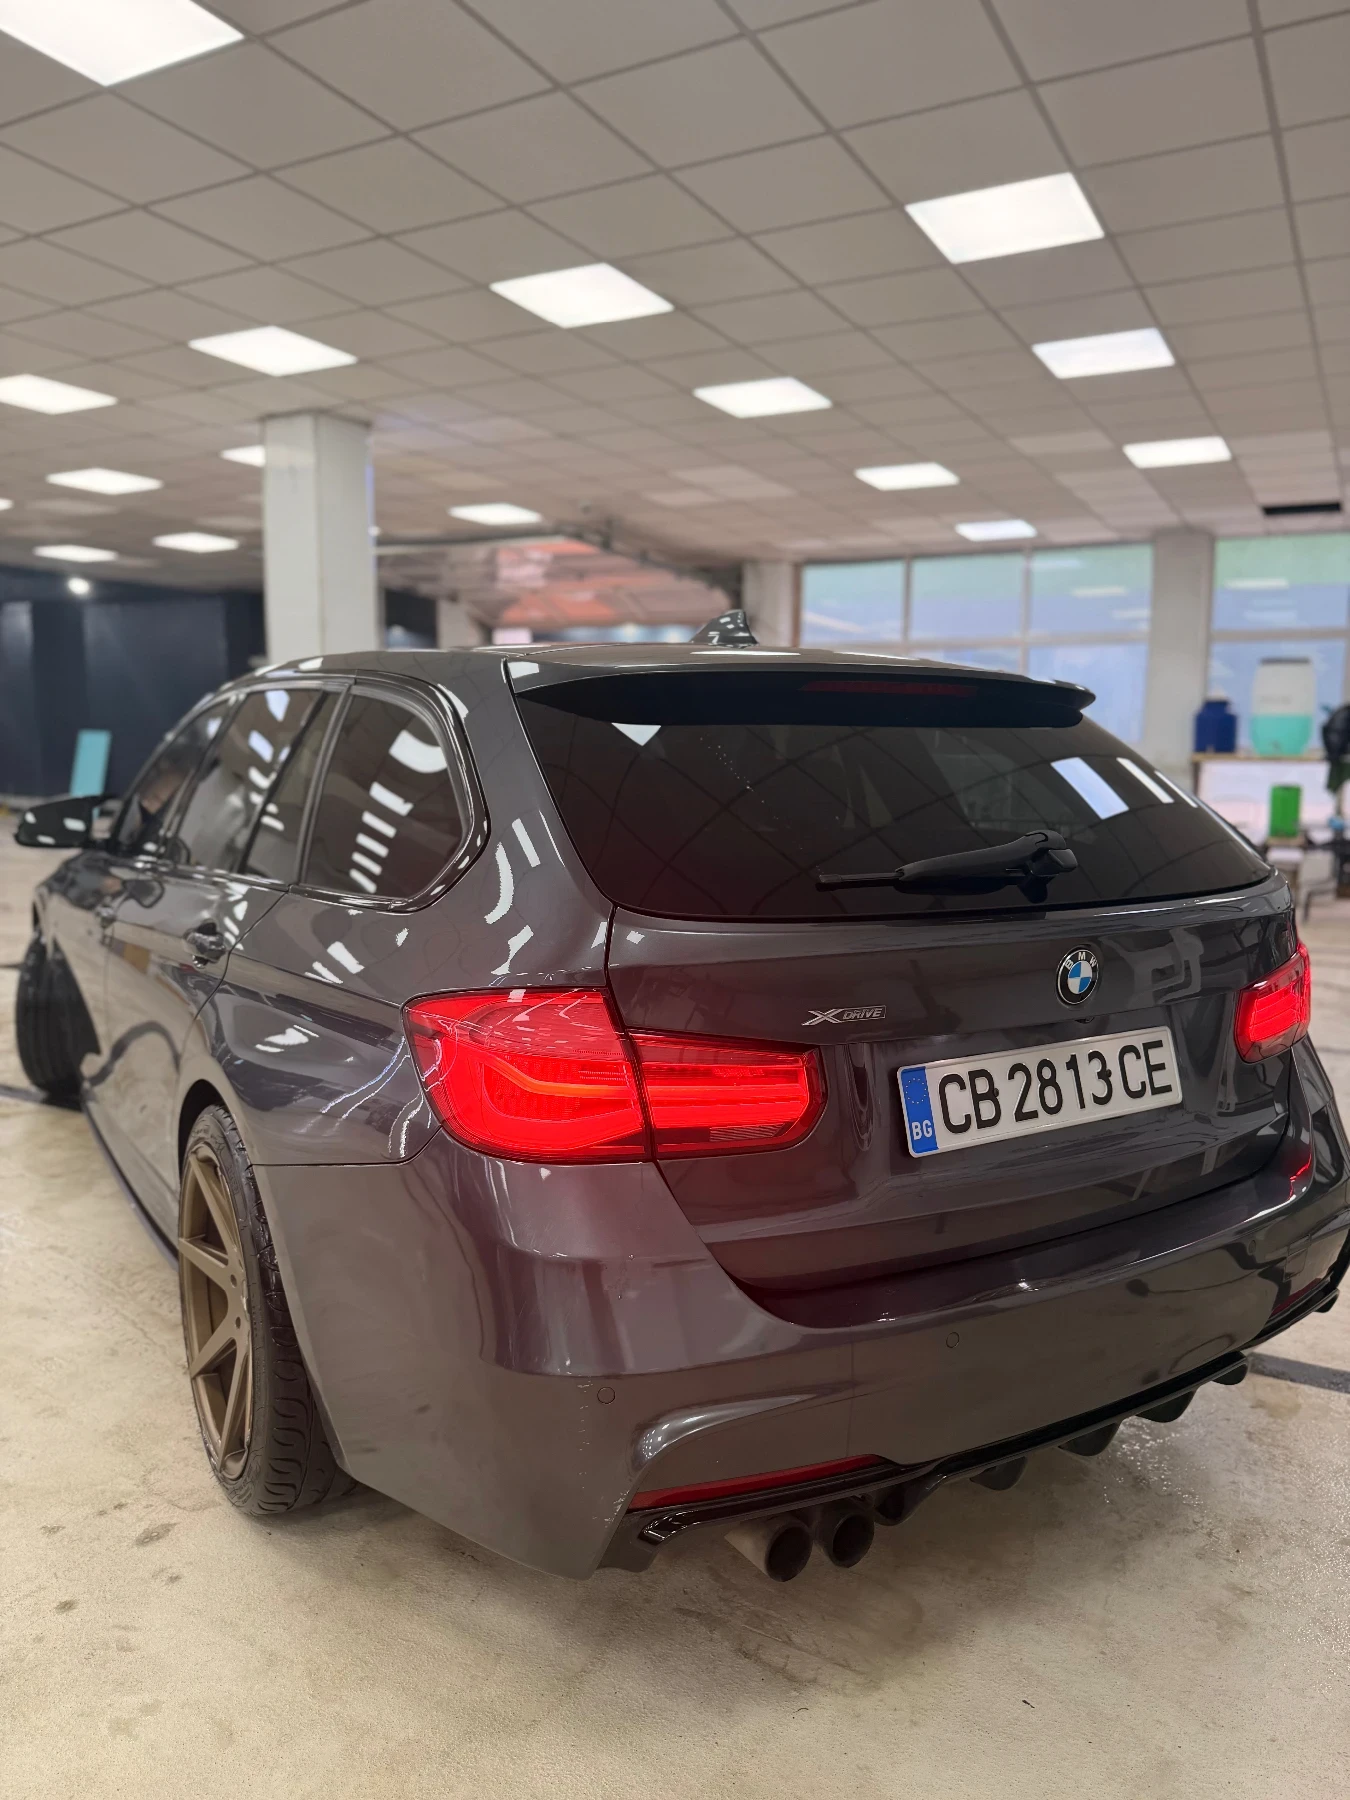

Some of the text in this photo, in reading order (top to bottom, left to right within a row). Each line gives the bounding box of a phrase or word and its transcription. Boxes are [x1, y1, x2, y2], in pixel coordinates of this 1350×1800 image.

[1064, 951, 1098, 970] BMW
[938, 1039, 1173, 1134] CB 2813 CE
[910, 1119, 933, 1140] BG
